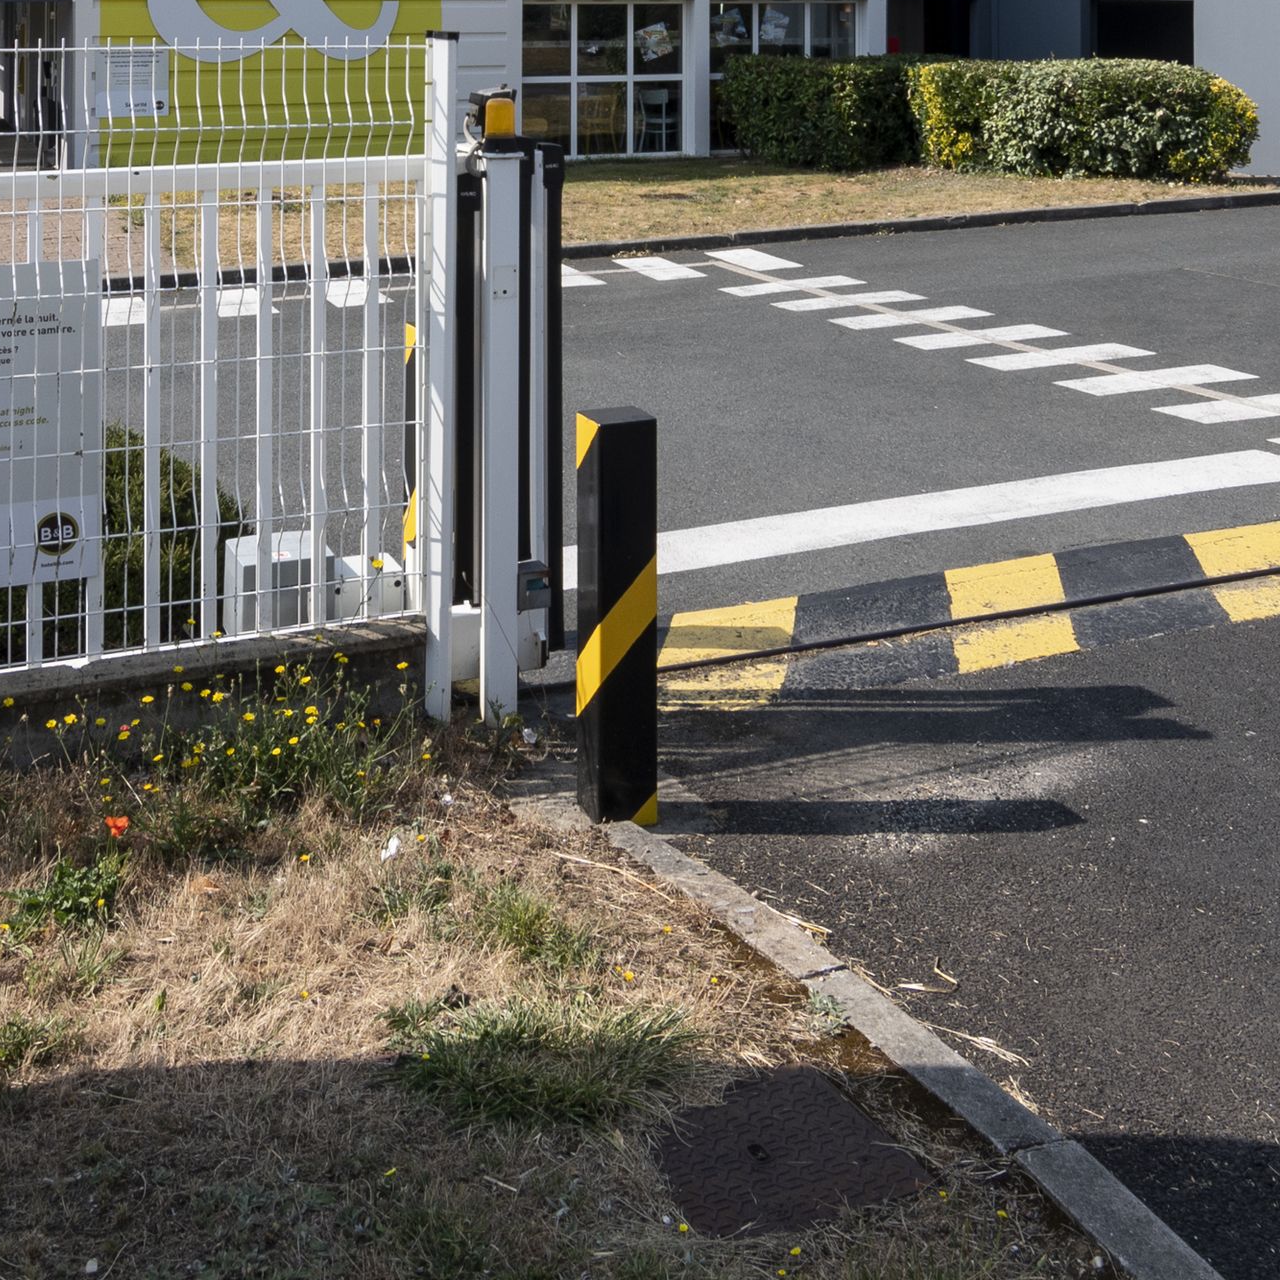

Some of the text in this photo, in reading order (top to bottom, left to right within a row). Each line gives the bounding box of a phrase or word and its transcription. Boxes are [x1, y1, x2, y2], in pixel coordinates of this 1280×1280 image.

[24, 315, 34, 324] la
[1, 329, 27, 338] votre
[0, 408, 9, 417] at
